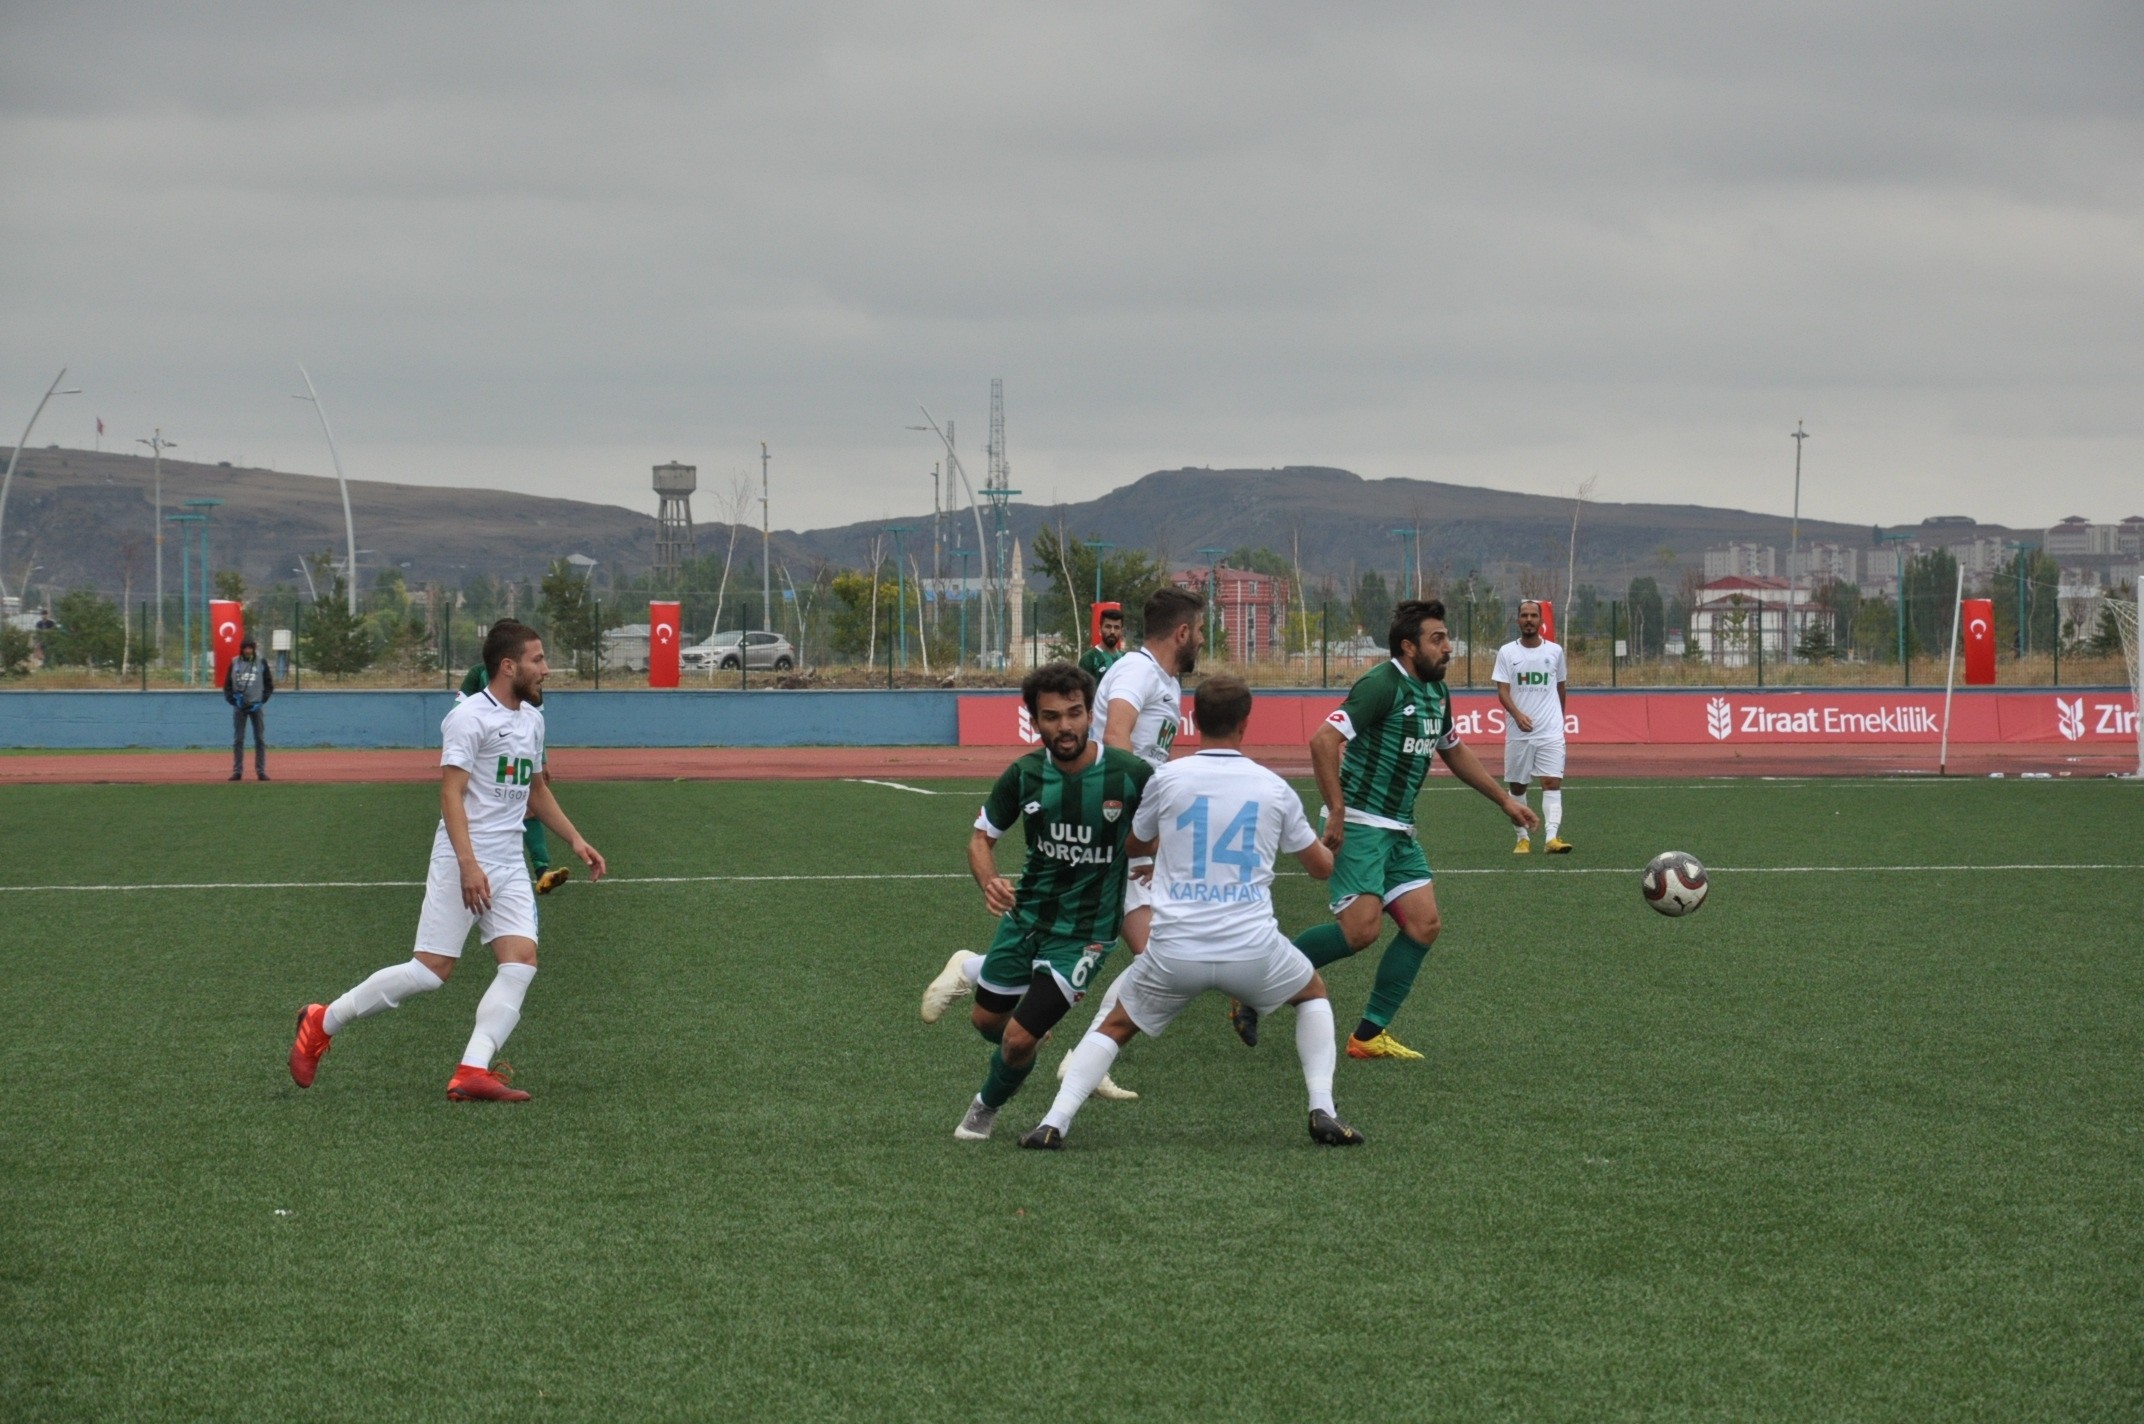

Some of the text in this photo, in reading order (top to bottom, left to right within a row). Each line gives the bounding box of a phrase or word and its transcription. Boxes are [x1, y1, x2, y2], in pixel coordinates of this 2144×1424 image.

[1517, 671, 1549, 685] HDI
[1423, 718, 1441, 735] ULU
[1740, 706, 1940, 733] Ziraat Emeklilik
[2094, 704, 2139, 733] Zir
[1050, 822, 1092, 844] ULU
[1176, 795, 1261, 883] 14
[1169, 882, 1264, 903] KARAHAN
[1071, 956, 1094, 987] 6
